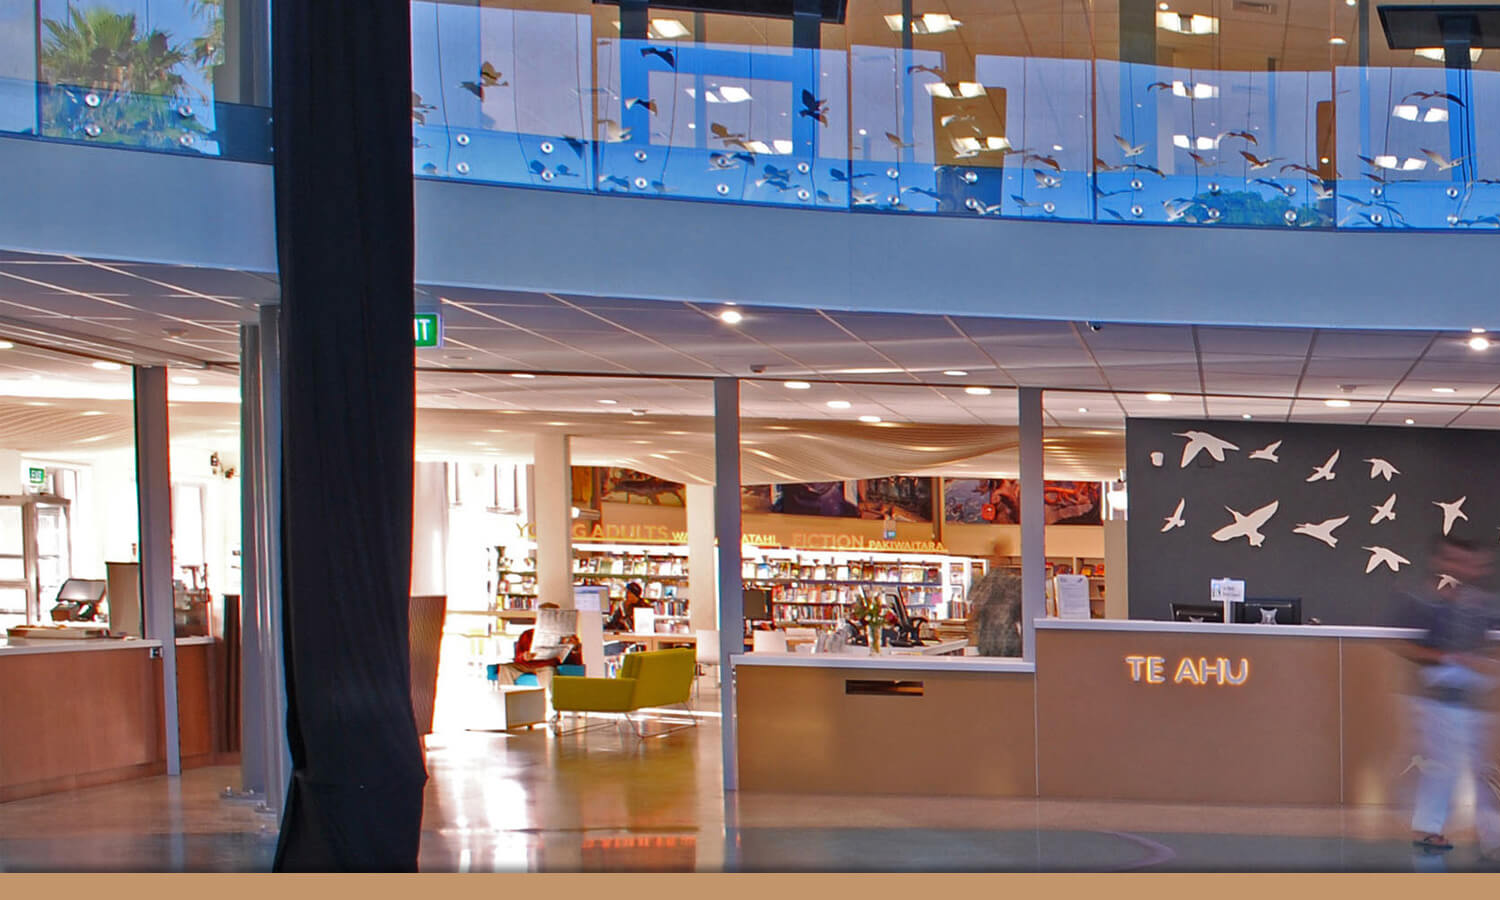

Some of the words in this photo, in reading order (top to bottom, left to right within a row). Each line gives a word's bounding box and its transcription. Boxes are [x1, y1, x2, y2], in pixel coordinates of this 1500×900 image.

[414, 319, 431, 341] IT
[516, 522, 587, 538] YOG
[592, 524, 669, 540] ADULTS
[793, 534, 864, 549] FICTION
[1125, 656, 1166, 683] TE
[1174, 657, 1248, 685] AHU
